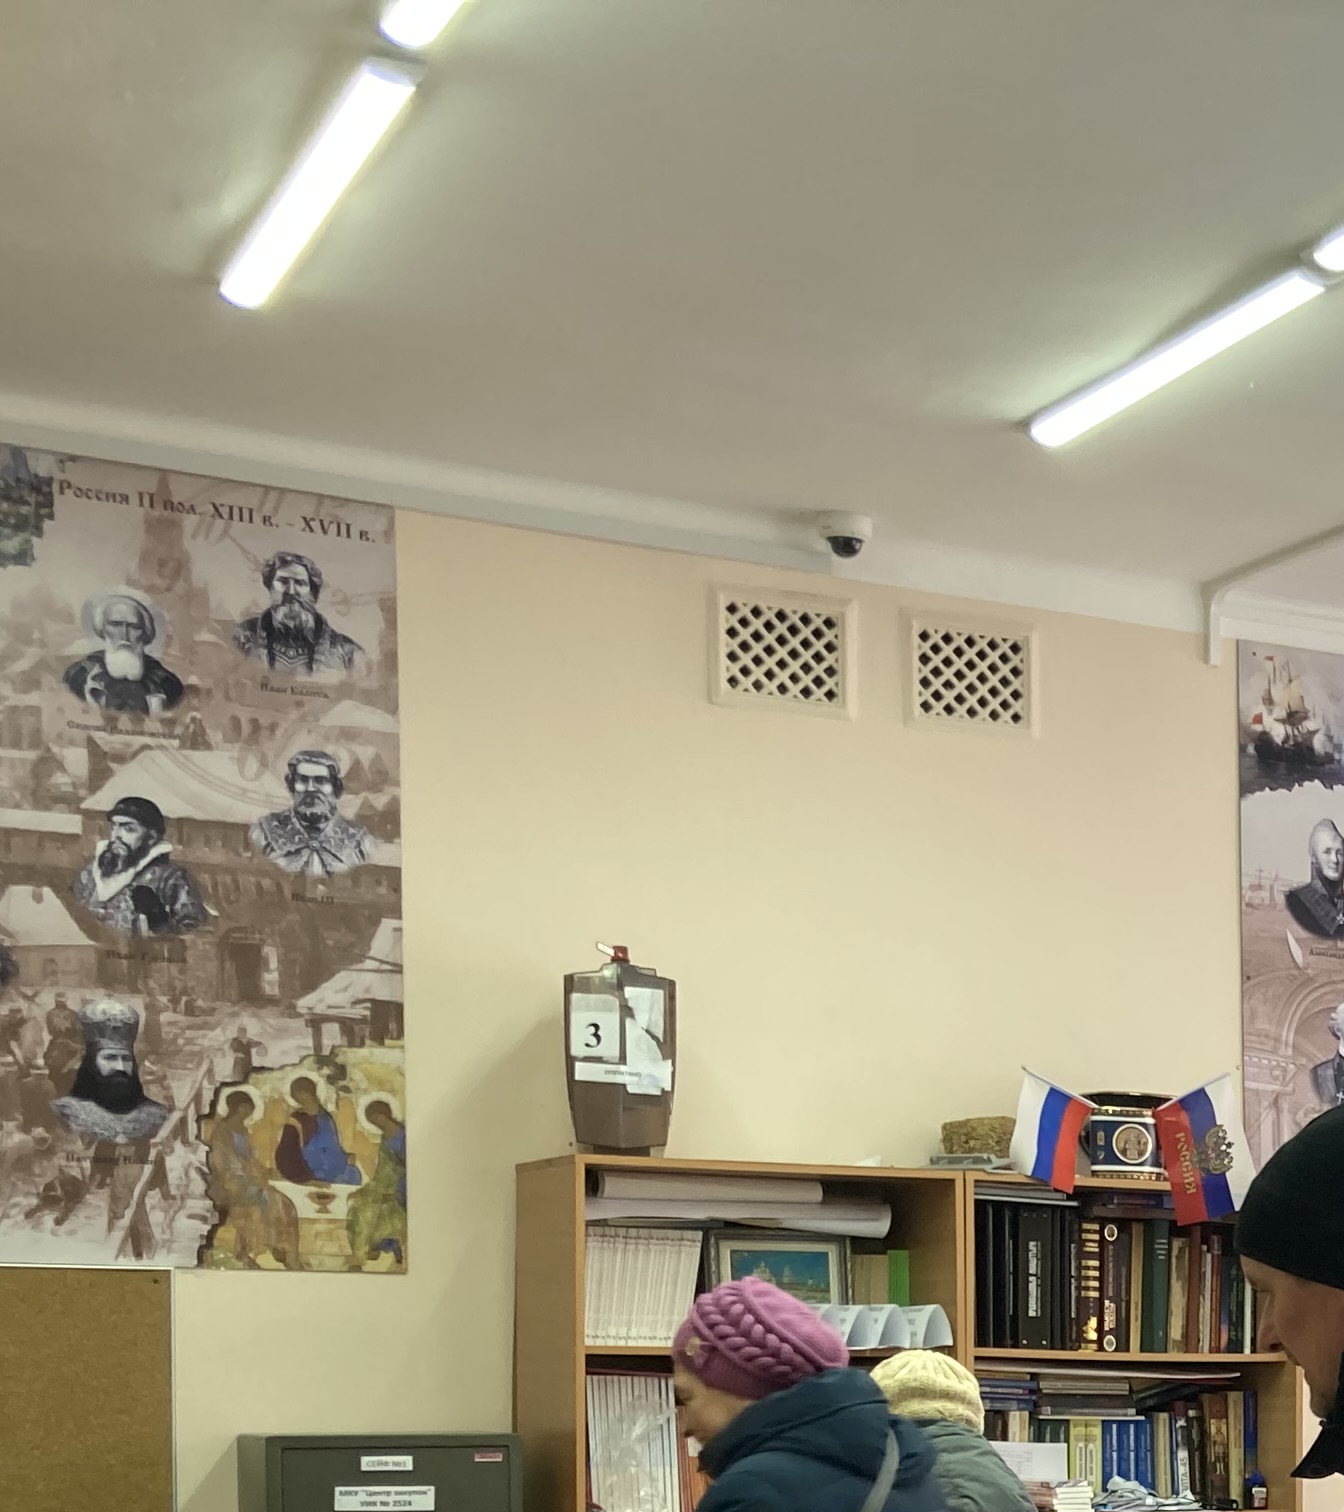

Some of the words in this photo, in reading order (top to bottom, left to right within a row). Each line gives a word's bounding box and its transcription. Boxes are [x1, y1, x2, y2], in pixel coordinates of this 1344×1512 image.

[58, 479, 130, 505] Россия
[137, 490, 156, 510] II
[208, 502, 255, 525] XIII
[262, 514, 280, 529] в.
[300, 516, 353, 540] XVII
[358, 529, 376, 544] в.
[584, 1022, 602, 1048] 3
[1174, 1131, 1198, 1195] РОССИЯ
